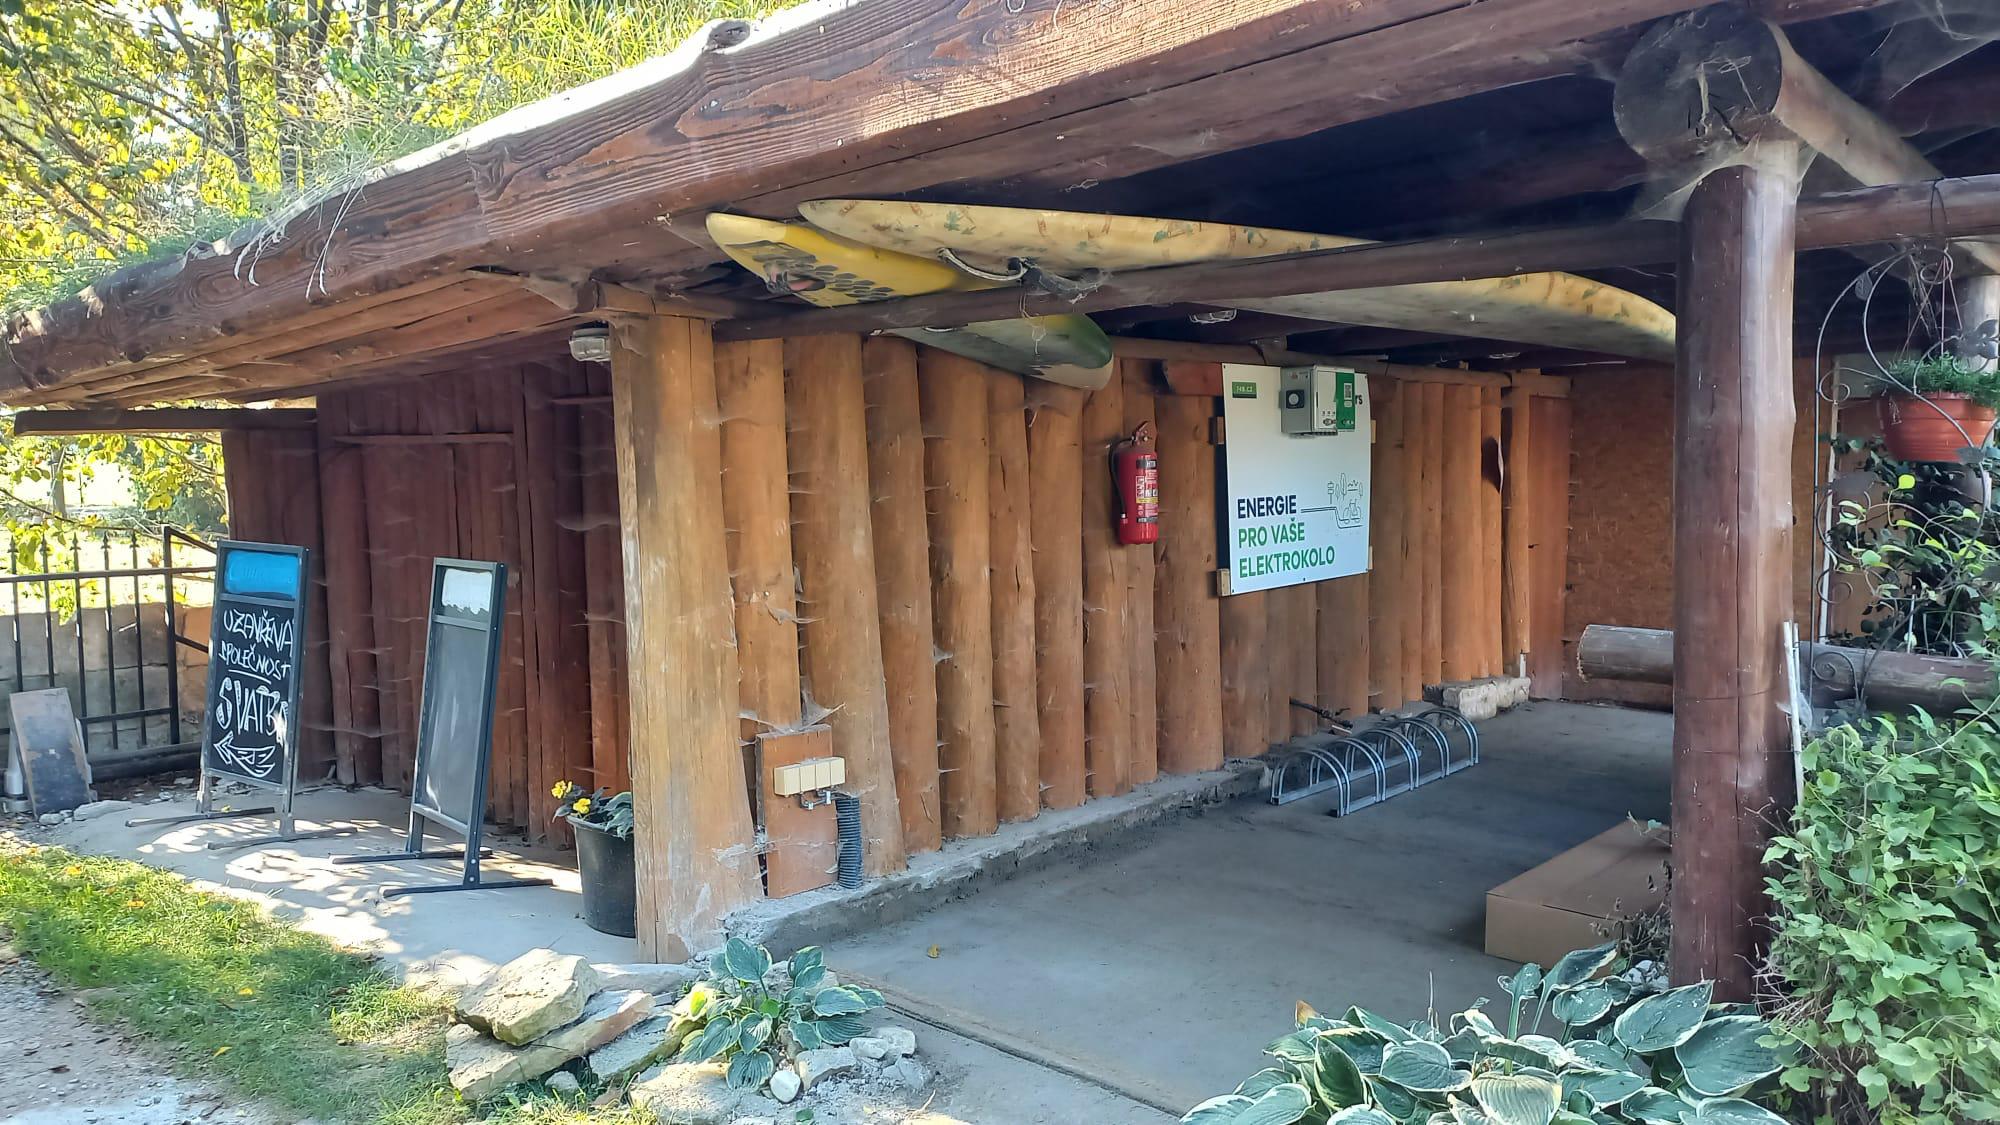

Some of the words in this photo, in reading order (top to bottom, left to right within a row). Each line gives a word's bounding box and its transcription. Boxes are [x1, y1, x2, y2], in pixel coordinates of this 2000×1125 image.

[1237, 494, 1297, 519] ENERGIE
[1238, 526, 1268, 549] PRO
[1270, 517, 1305, 545] VAŠE
[1239, 545, 1335, 579] ELEKTROKOLO
[218, 640, 291, 680] SPOLEČNOST
